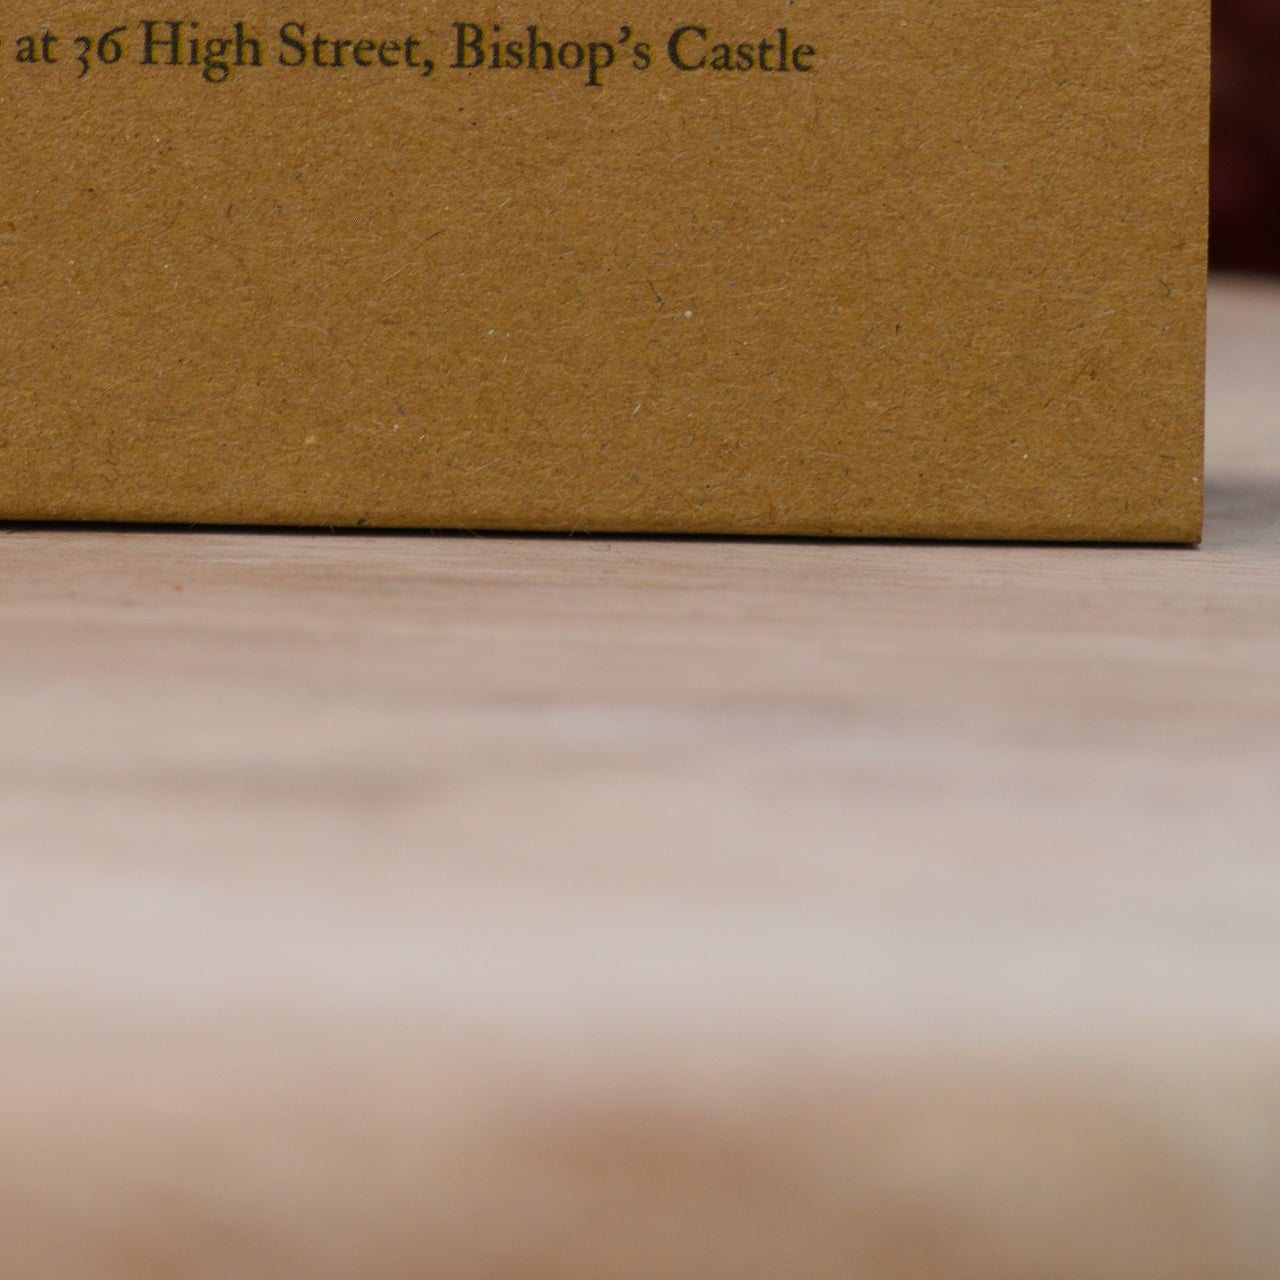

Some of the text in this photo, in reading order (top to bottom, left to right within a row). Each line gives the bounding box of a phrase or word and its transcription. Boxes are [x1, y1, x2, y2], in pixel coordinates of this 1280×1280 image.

[15, 30, 59, 65] at
[73, 25, 128, 79] 36
[139, 19, 263, 84] High
[278, 21, 435, 78] Street,
[449, 21, 651, 88] Bishop's
[667, 24, 816, 73] Castle
